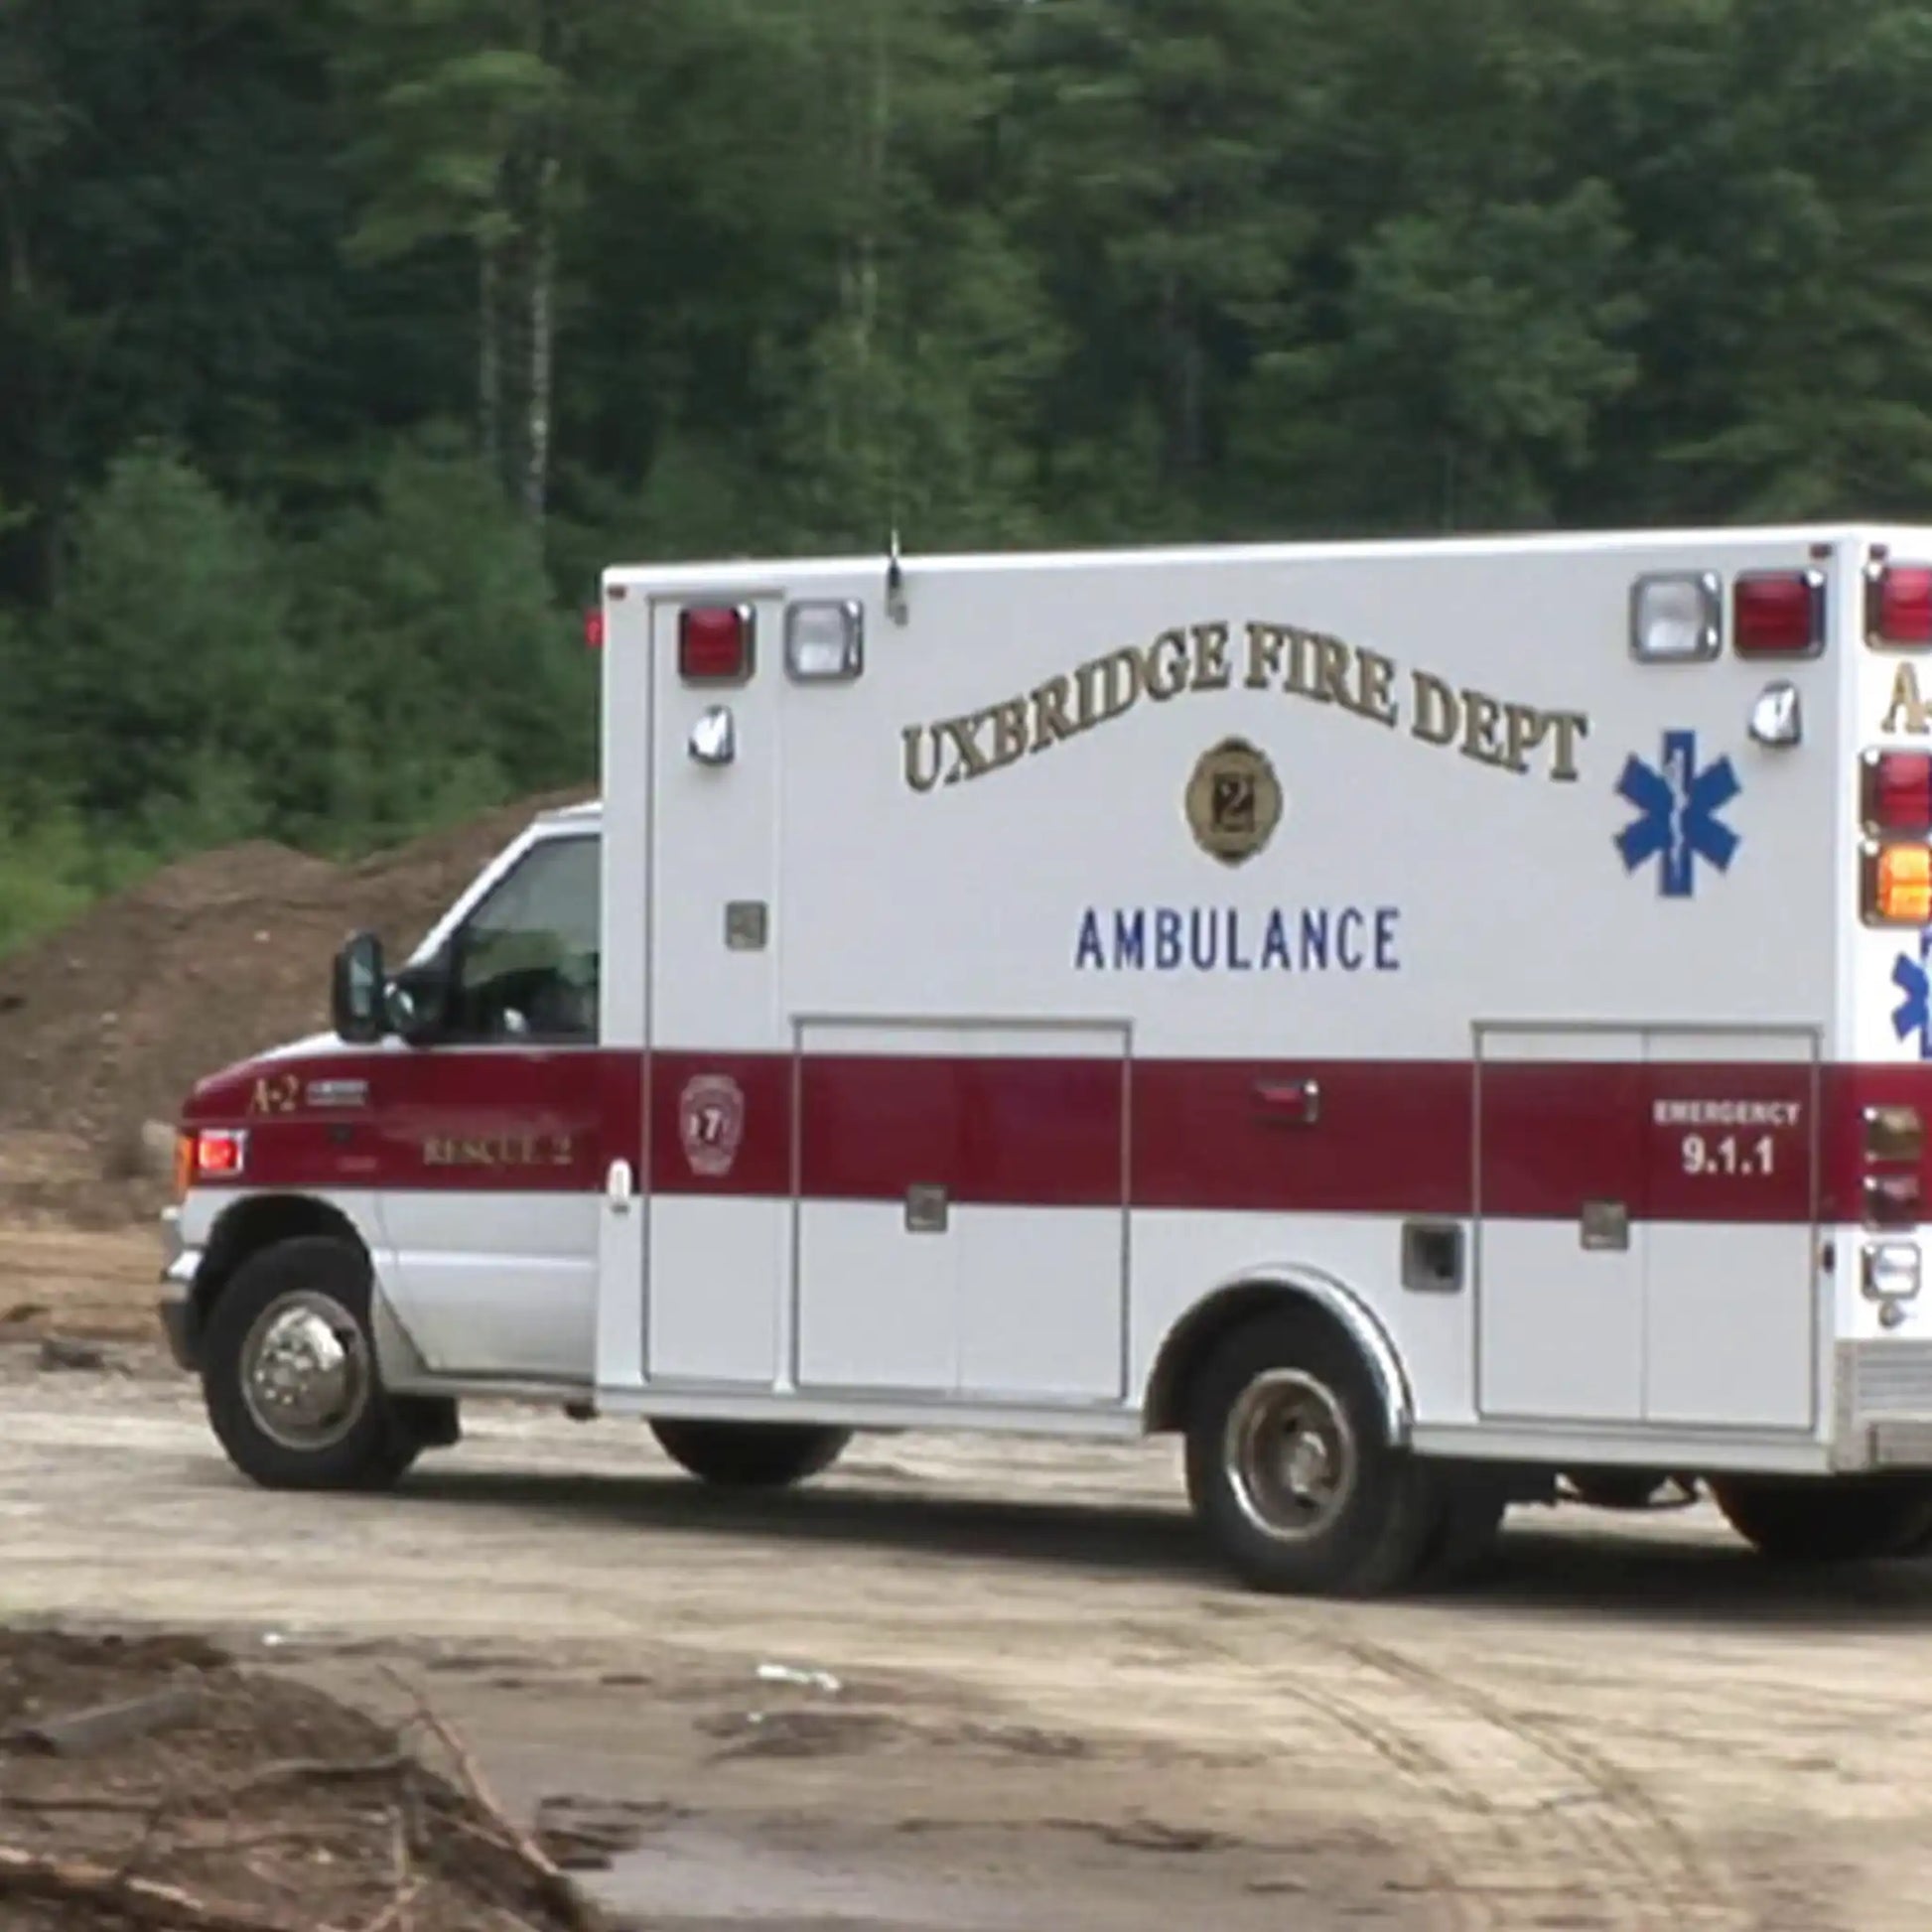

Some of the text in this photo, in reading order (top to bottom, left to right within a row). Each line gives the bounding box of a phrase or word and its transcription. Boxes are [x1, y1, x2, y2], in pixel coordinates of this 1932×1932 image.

[902, 621, 1589, 791] UXBRIDGE FIRE DEPT
[1075, 907, 1401, 971] AMBULANCE
[1653, 1100, 1801, 1126] EMERGENCY
[422, 1136, 544, 1166] RESCUE
[1682, 1134, 1774, 1174] 9.1.1
